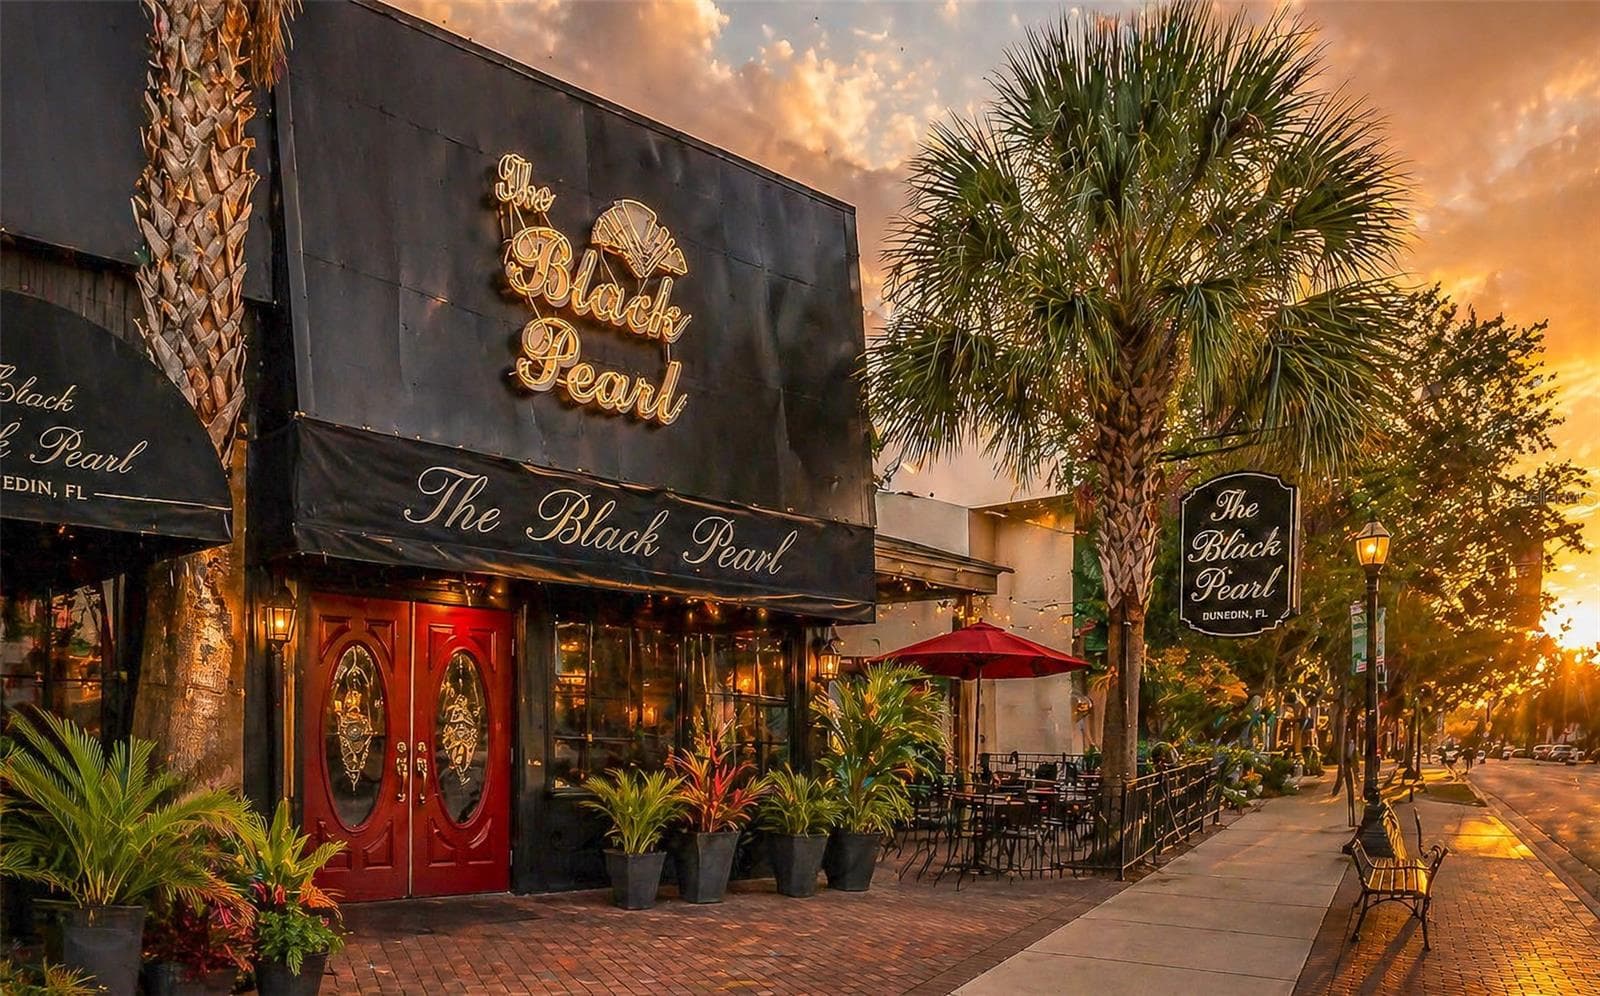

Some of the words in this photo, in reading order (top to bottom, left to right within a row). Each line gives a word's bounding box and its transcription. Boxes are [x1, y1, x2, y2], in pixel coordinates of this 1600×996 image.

[495, 153, 557, 213] The
[504, 226, 692, 343] Black
[515, 317, 688, 425] Pearl
[29, 426, 148, 474] Pearl
[0, 474, 57, 499] EDIN,
[65, 483, 88, 500] FL
[1210, 488, 1260, 522] The
[403, 466, 501, 533] The
[525, 489, 669, 557] Black
[683, 516, 798, 576] Pearl
[1187, 526, 1283, 563] Black
[1190, 564, 1284, 602] Pearl
[1202, 609, 1253, 621] DUNEDIN,
[1255, 608, 1269, 619] FL
